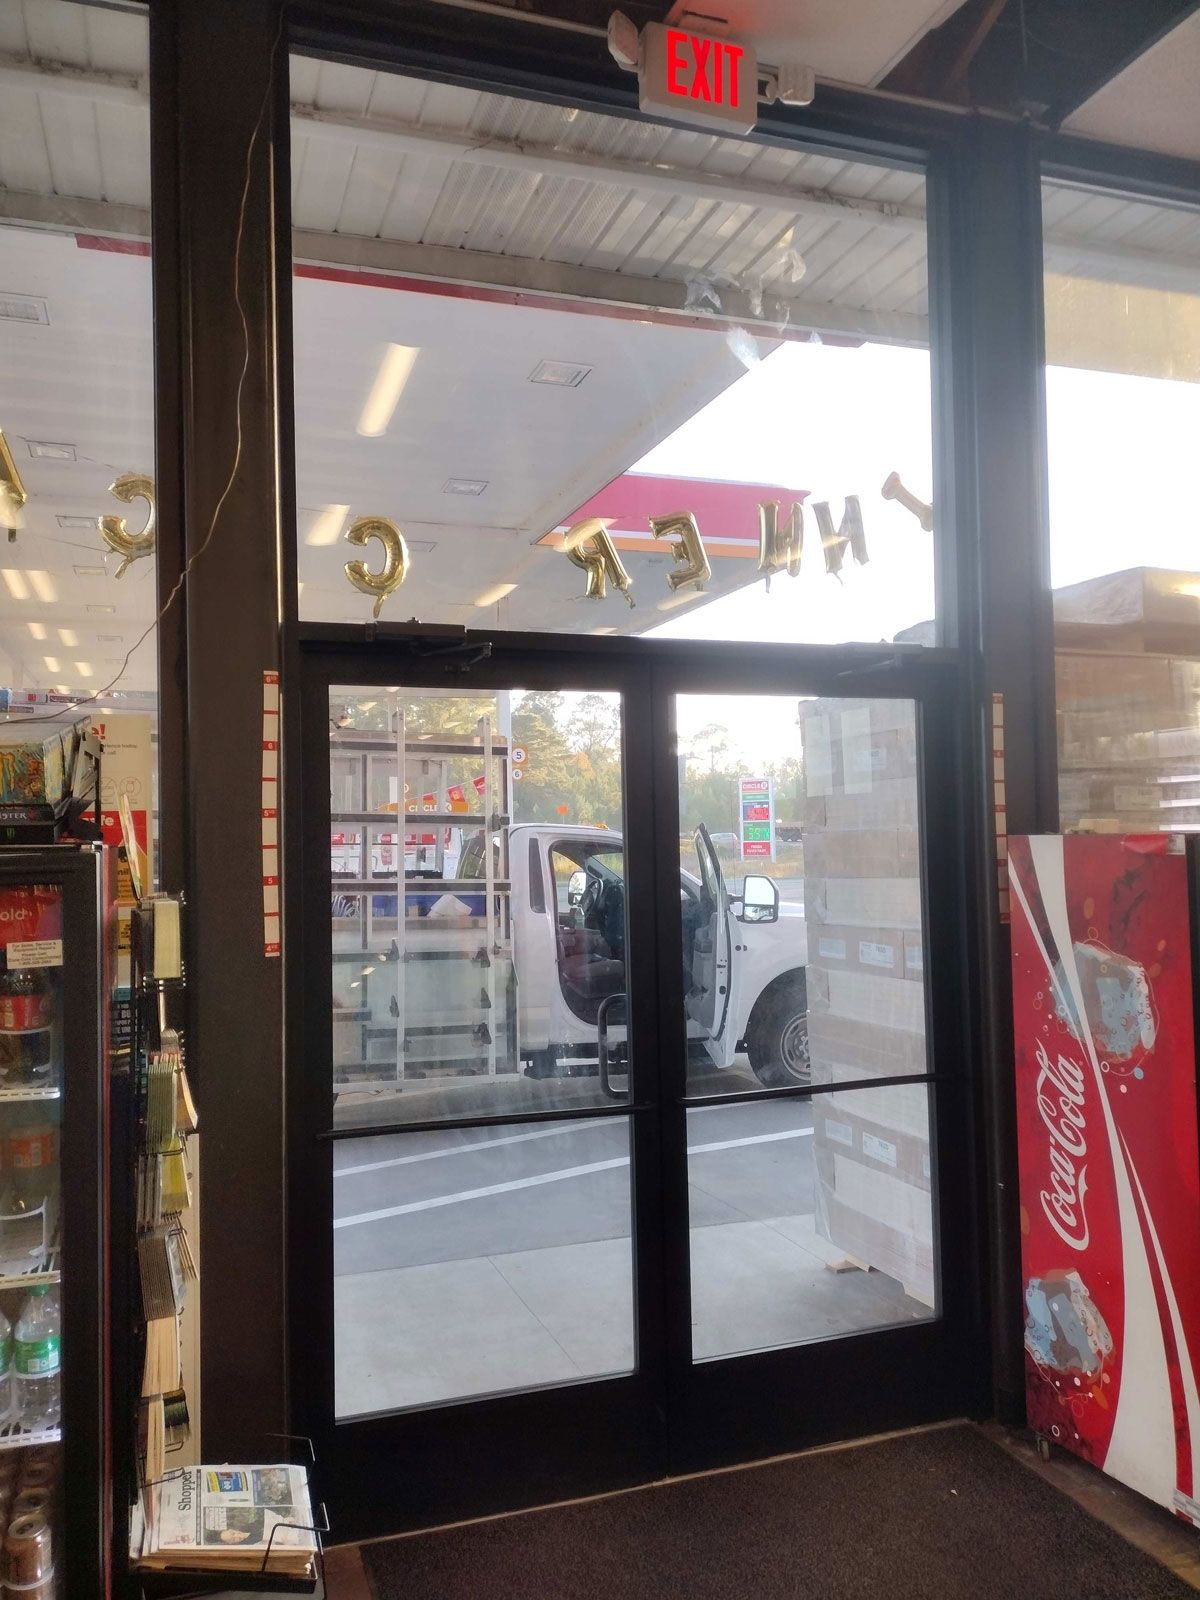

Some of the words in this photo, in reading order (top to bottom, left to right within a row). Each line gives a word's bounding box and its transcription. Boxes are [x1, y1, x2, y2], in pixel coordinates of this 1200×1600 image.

[667, 29, 743, 108] EXIT
[516, 751, 522, 760] 5
[408, 804, 438, 812] CICLE
[1035, 1037, 1089, 1251] Coca-Cola
[178, 1470, 196, 1512] Shopper
